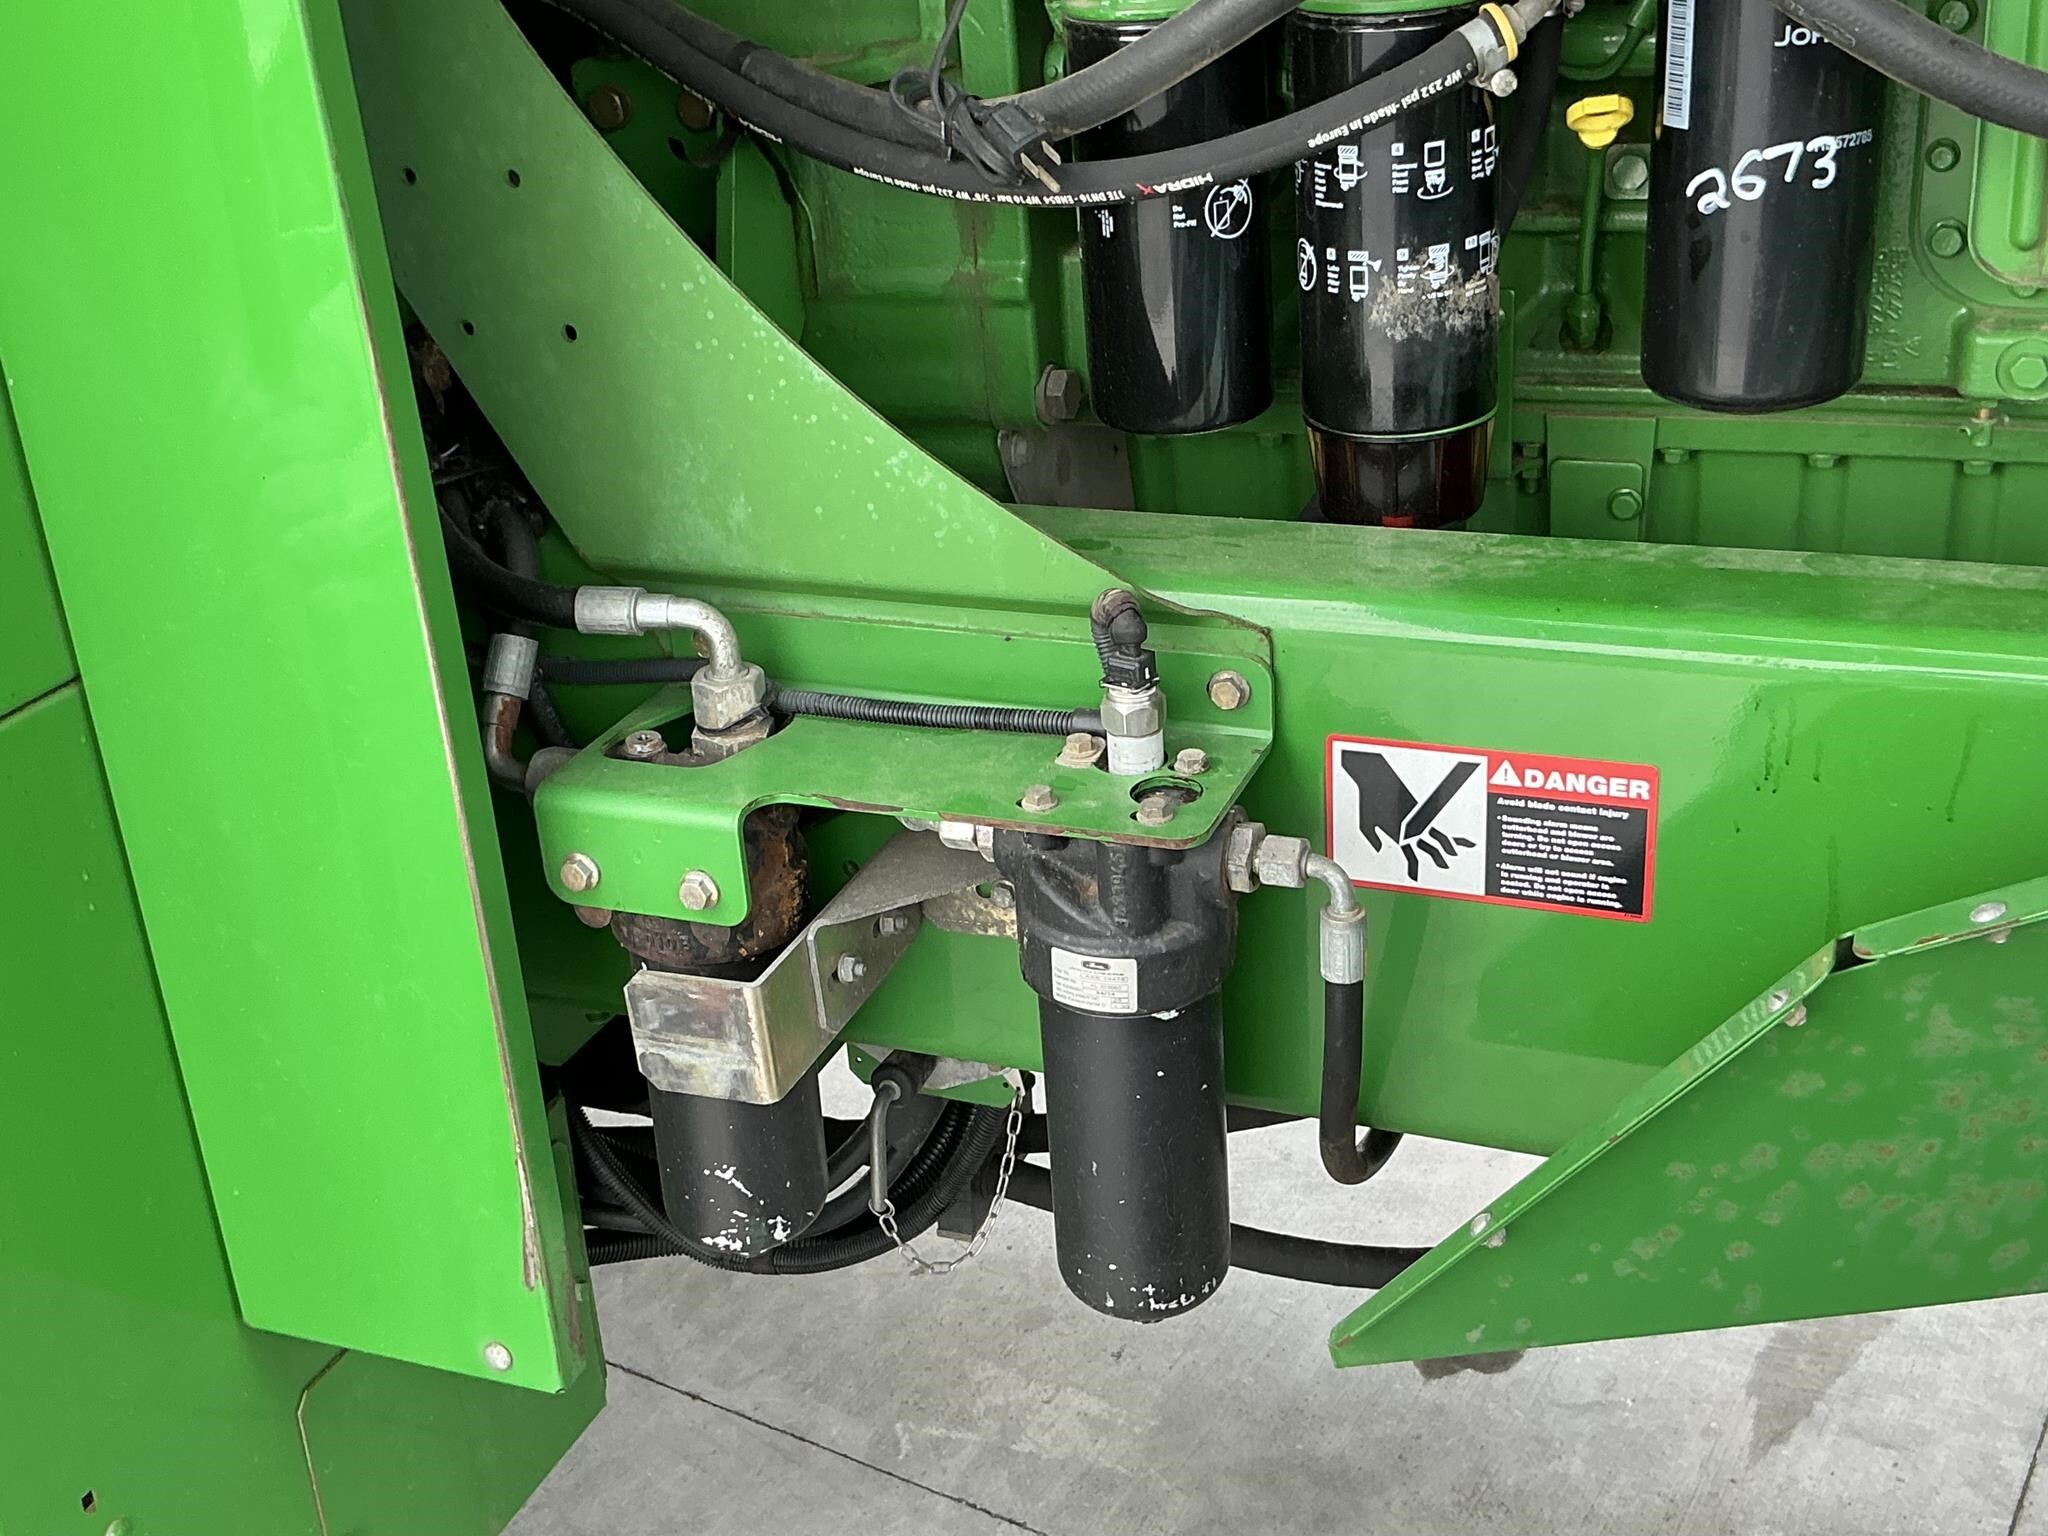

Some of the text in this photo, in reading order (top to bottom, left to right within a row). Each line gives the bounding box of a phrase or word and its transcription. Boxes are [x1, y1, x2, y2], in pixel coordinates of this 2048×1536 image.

[1774, 25, 1830, 47] JOH
[1421, 79, 1444, 98] 232
[1444, 69, 1463, 88] WP
[1307, 125, 1350, 149] Europe
[1136, 172, 1214, 195] HIDRAX
[1686, 135, 1836, 215] 2673
[1524, 768, 1650, 800] DANGER
[1497, 797, 1525, 807] Avoid
[1558, 805, 1597, 815] contact
[1599, 808, 1629, 819] injury
